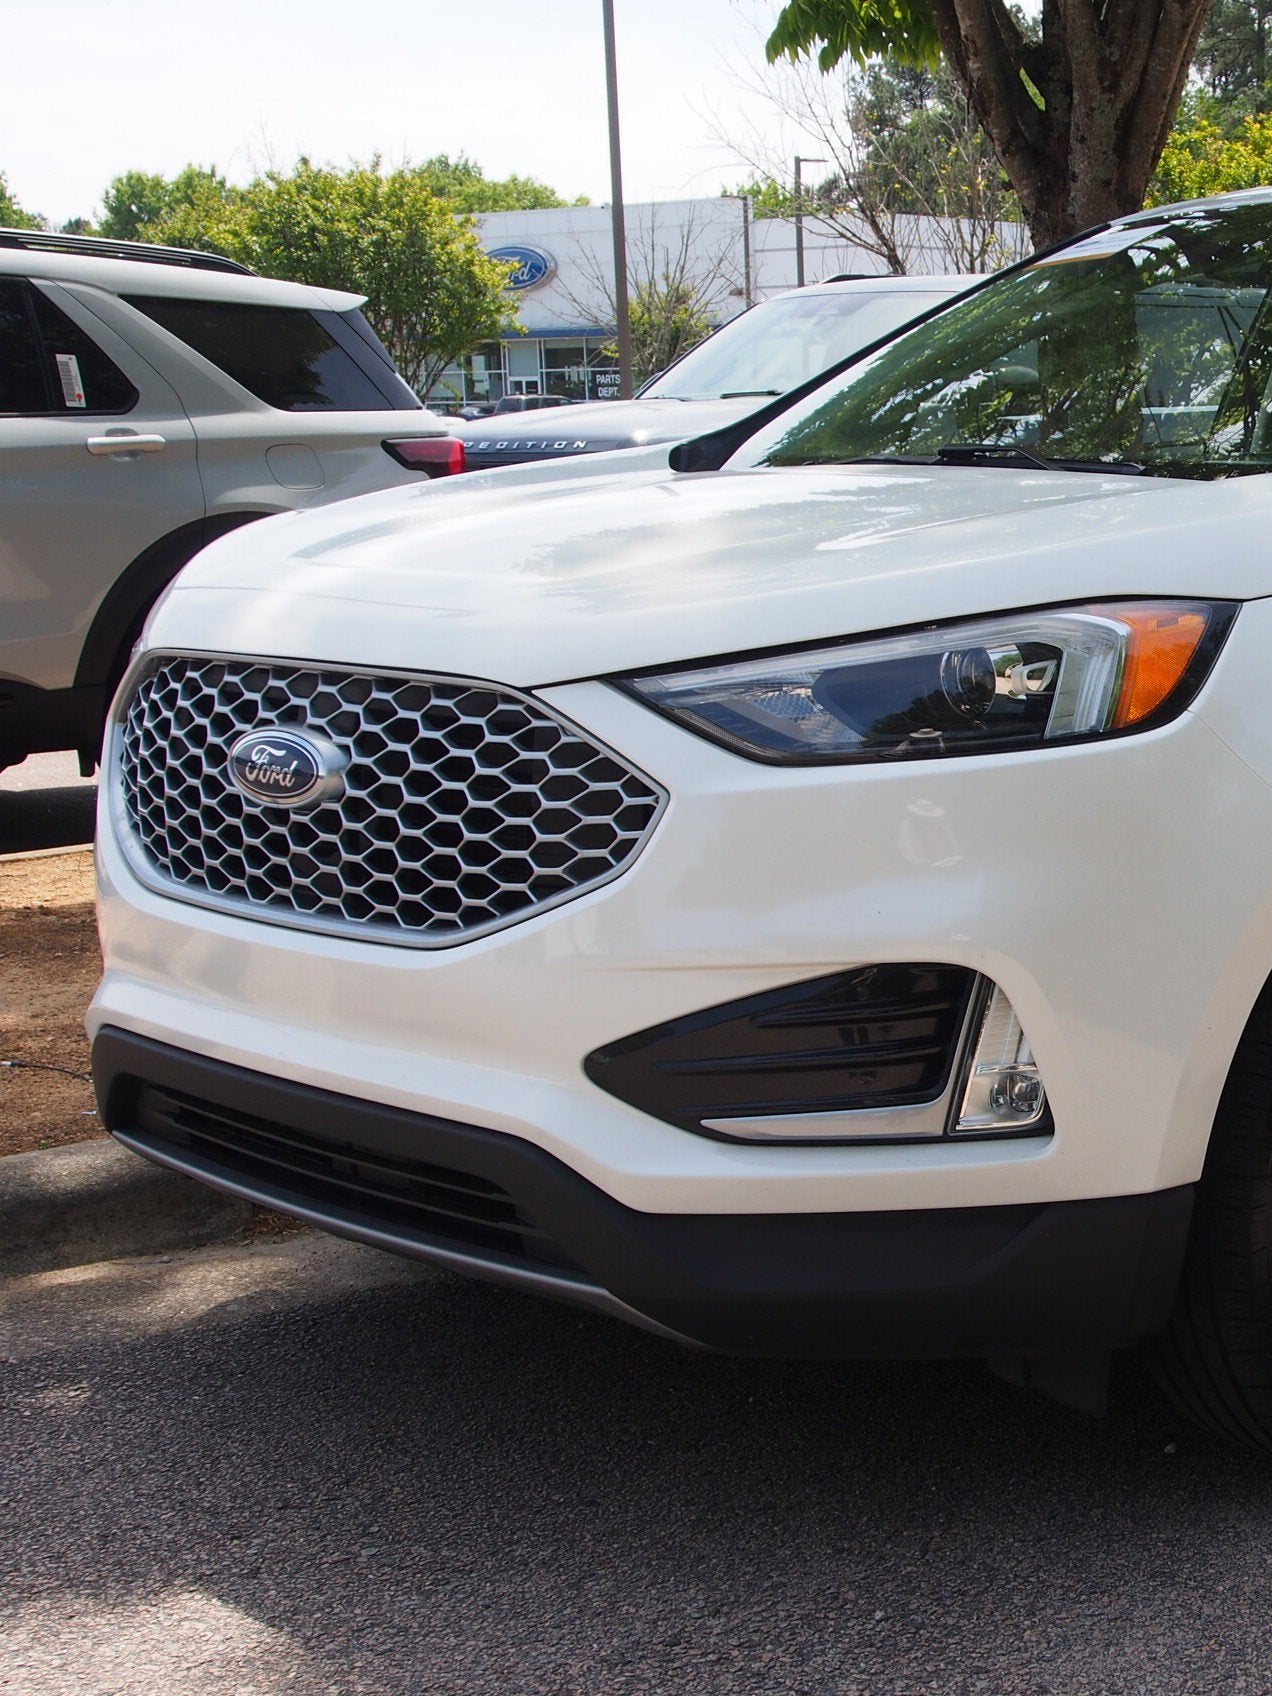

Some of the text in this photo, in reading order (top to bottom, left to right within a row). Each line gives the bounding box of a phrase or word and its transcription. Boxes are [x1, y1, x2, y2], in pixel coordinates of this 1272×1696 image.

[596, 374, 621, 384] PARTS
[598, 387, 620, 397] DEPT.
[245, 744, 298, 787] Ford
